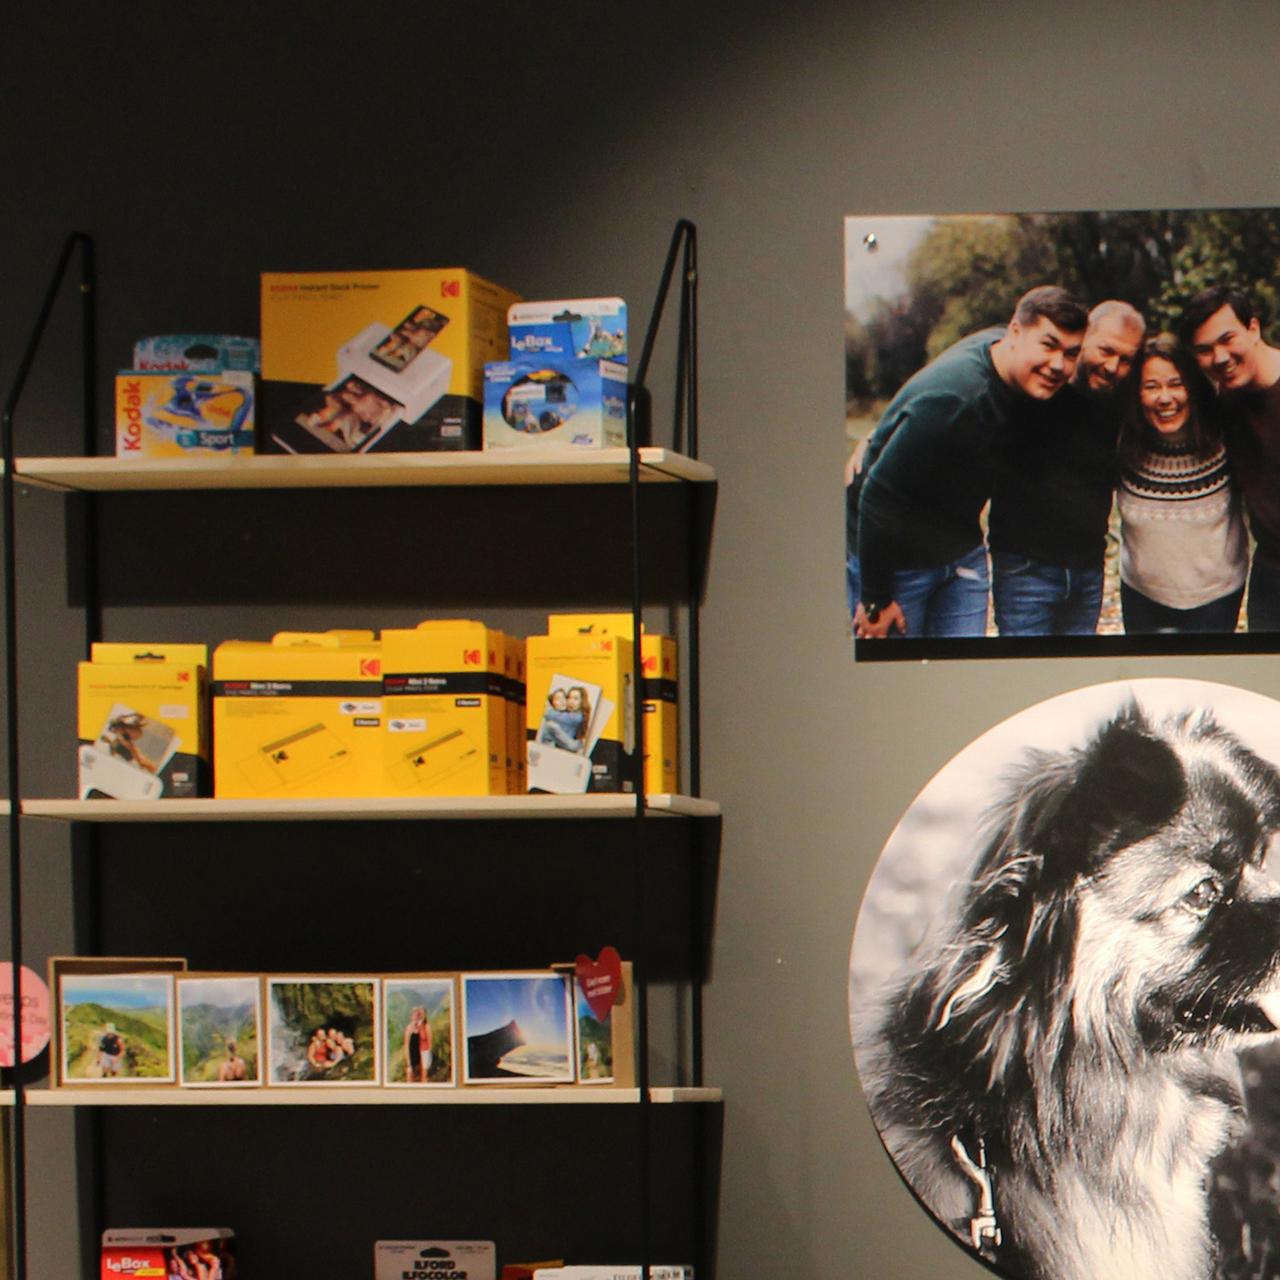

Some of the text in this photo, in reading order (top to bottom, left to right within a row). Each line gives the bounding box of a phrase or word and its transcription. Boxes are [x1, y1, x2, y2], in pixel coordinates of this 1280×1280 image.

[511, 335, 553, 351] LeBox
[140, 360, 188, 371] Kodak
[123, 380, 142, 452] Kodak
[200, 431, 234, 447] Sport
[106, 1257, 150, 1272] LeBox
[414, 1260, 456, 1271] ILFORD
[402, 1271, 468, 1280] ILFOCOLOR
